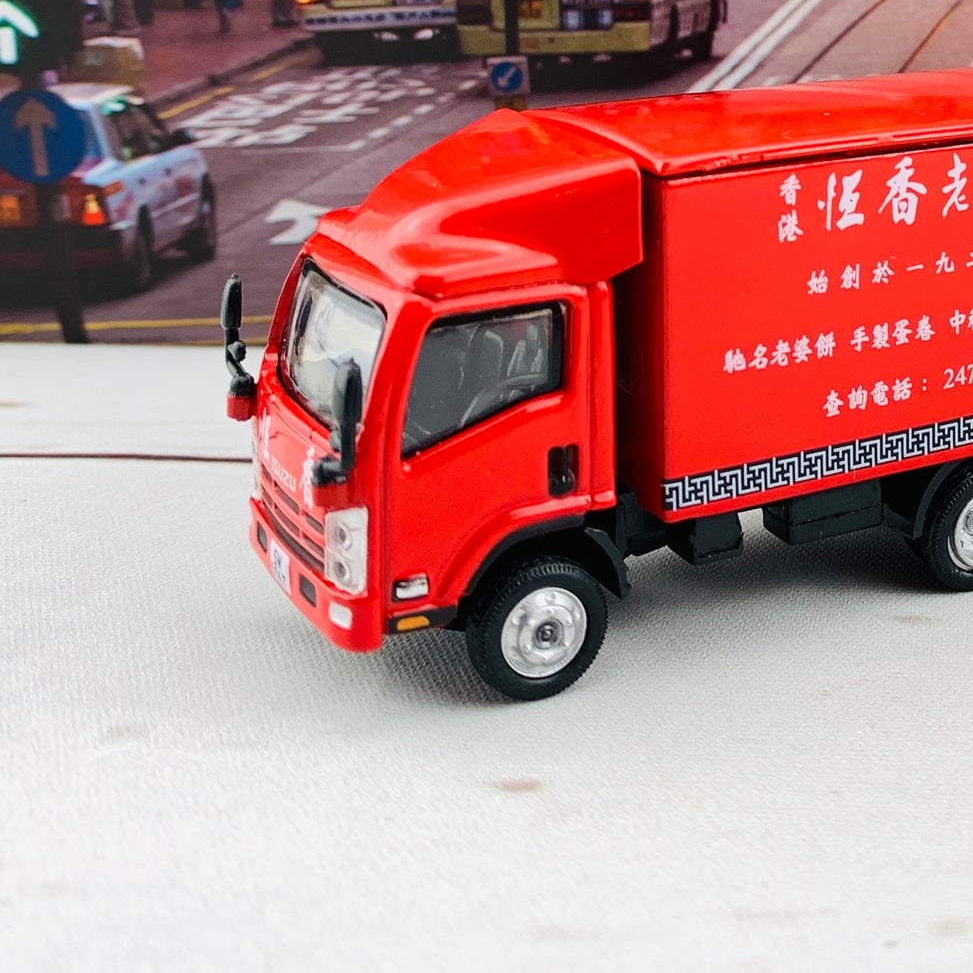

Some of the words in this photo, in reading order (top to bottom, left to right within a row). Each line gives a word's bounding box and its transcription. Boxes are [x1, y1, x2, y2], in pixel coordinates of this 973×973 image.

[778, 173, 804, 244] 香港
[722, 331, 837, 374] 馳名老婆餅
[849, 314, 937, 353] 手製蛋卷
[271, 454, 297, 494] ISUZU
